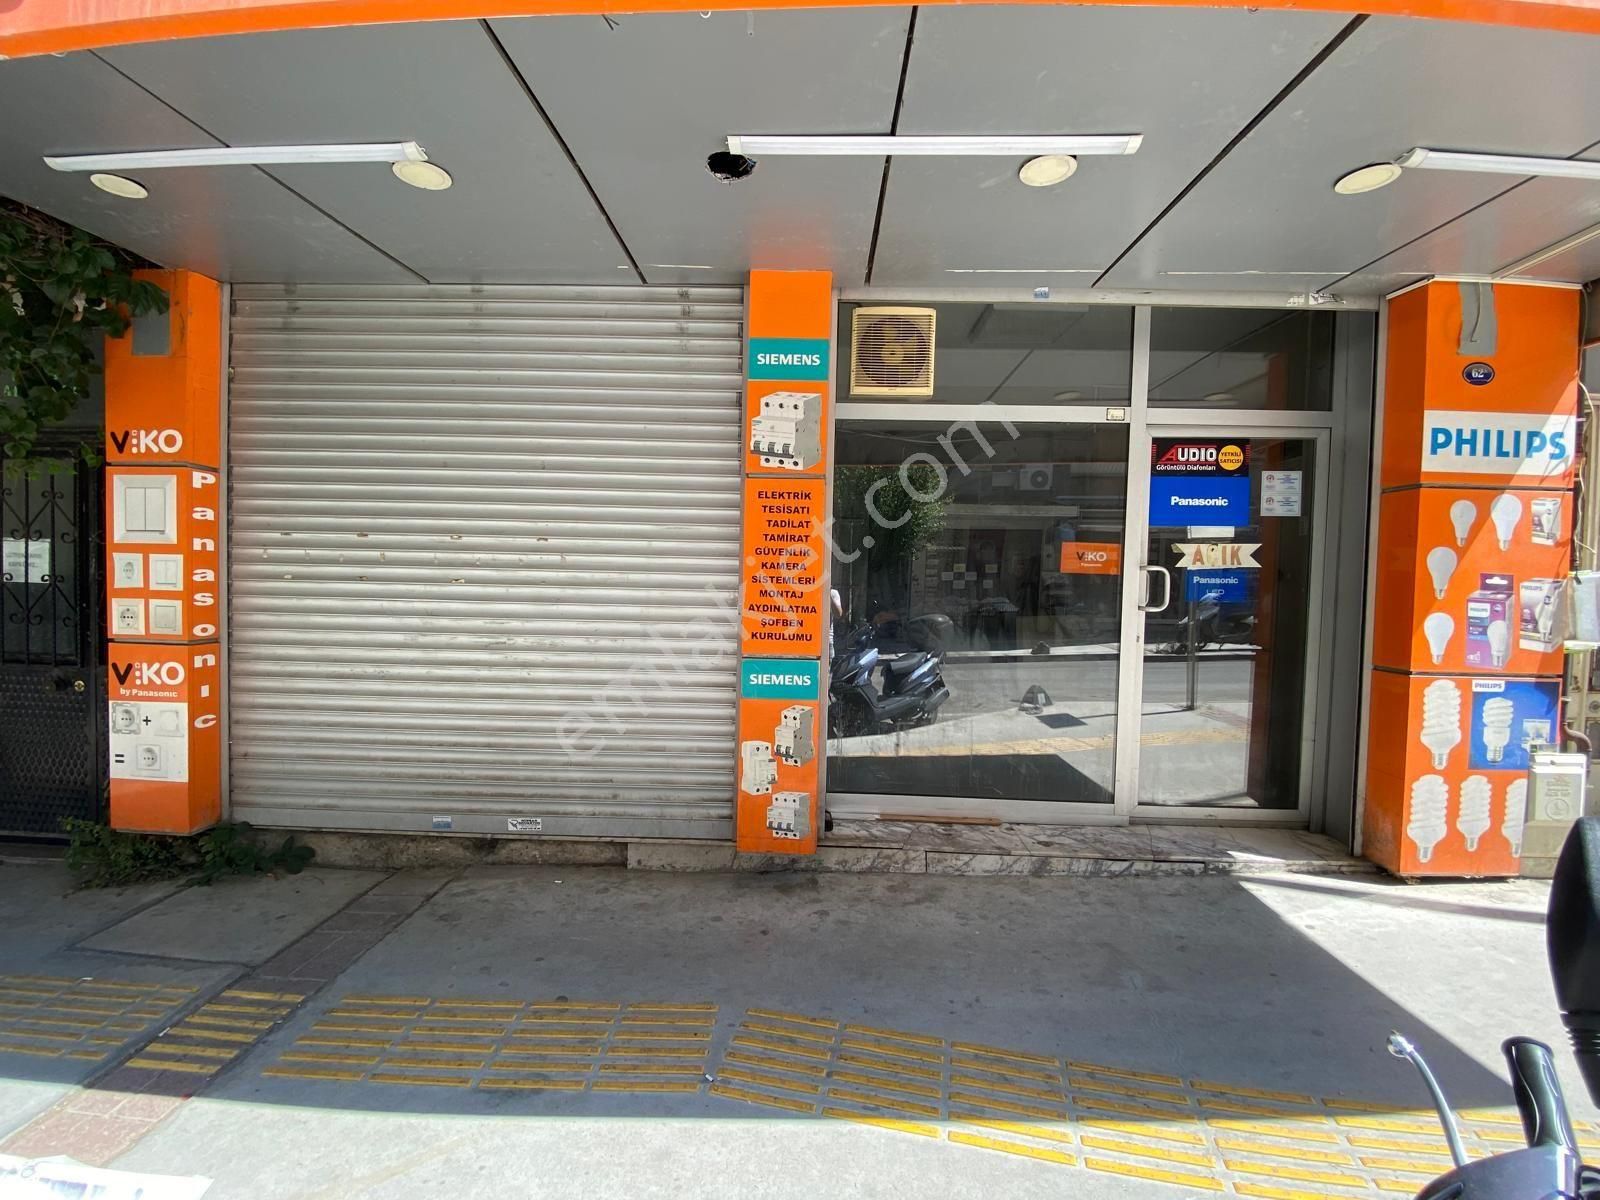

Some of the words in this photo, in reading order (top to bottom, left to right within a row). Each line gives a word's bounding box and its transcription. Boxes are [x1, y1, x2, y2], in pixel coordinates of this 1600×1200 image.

[757, 353, 820, 366] SIEMENS
[1430, 427, 1567, 460] PHILIPS
[1158, 445, 1217, 463] AUDIO
[758, 490, 812, 500] ELEKTRİK
[1170, 496, 1229, 507] Panasonic
[762, 504, 810, 514] TESİSATI
[766, 518, 811, 528] TADİLAT
[763, 532, 811, 543] TAMİRAT
[755, 546, 811, 557] GÜVENLİK
[761, 562, 807, 571] KAMERA
[751, 575, 816, 585] SİSTEMLERİ
[1193, 576, 1239, 584] Panasonic
[760, 589, 804, 599] MONTAJ
[748, 604, 817, 614] AYDINLATMA
[761, 618, 804, 628] ŞOFBEN
[751, 631, 813, 642] KURULUMU
[749, 673, 812, 686] SIEMENS
[120, 687, 131, 697] by
[131, 688, 178, 698] Panasonic
